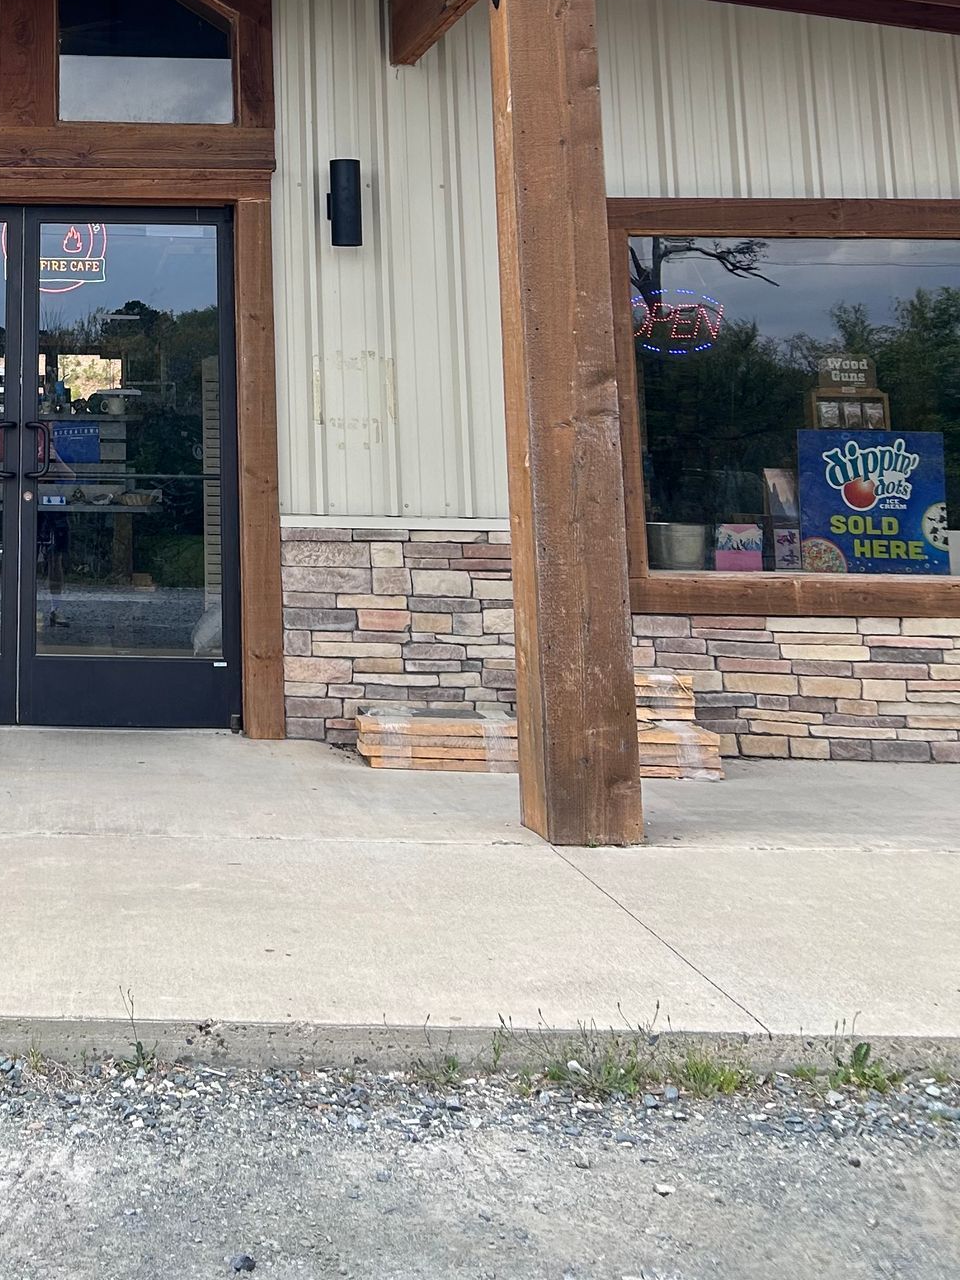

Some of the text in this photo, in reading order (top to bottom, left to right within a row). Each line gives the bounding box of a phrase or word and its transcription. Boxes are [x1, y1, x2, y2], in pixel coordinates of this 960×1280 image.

[70, 261, 100, 272] CAFE
[827, 357, 868, 370] Wood
[831, 370, 866, 382] Guns
[874, 478, 911, 497] dots
[830, 515, 899, 535] SOLD
[854, 540, 925, 559] HERE
